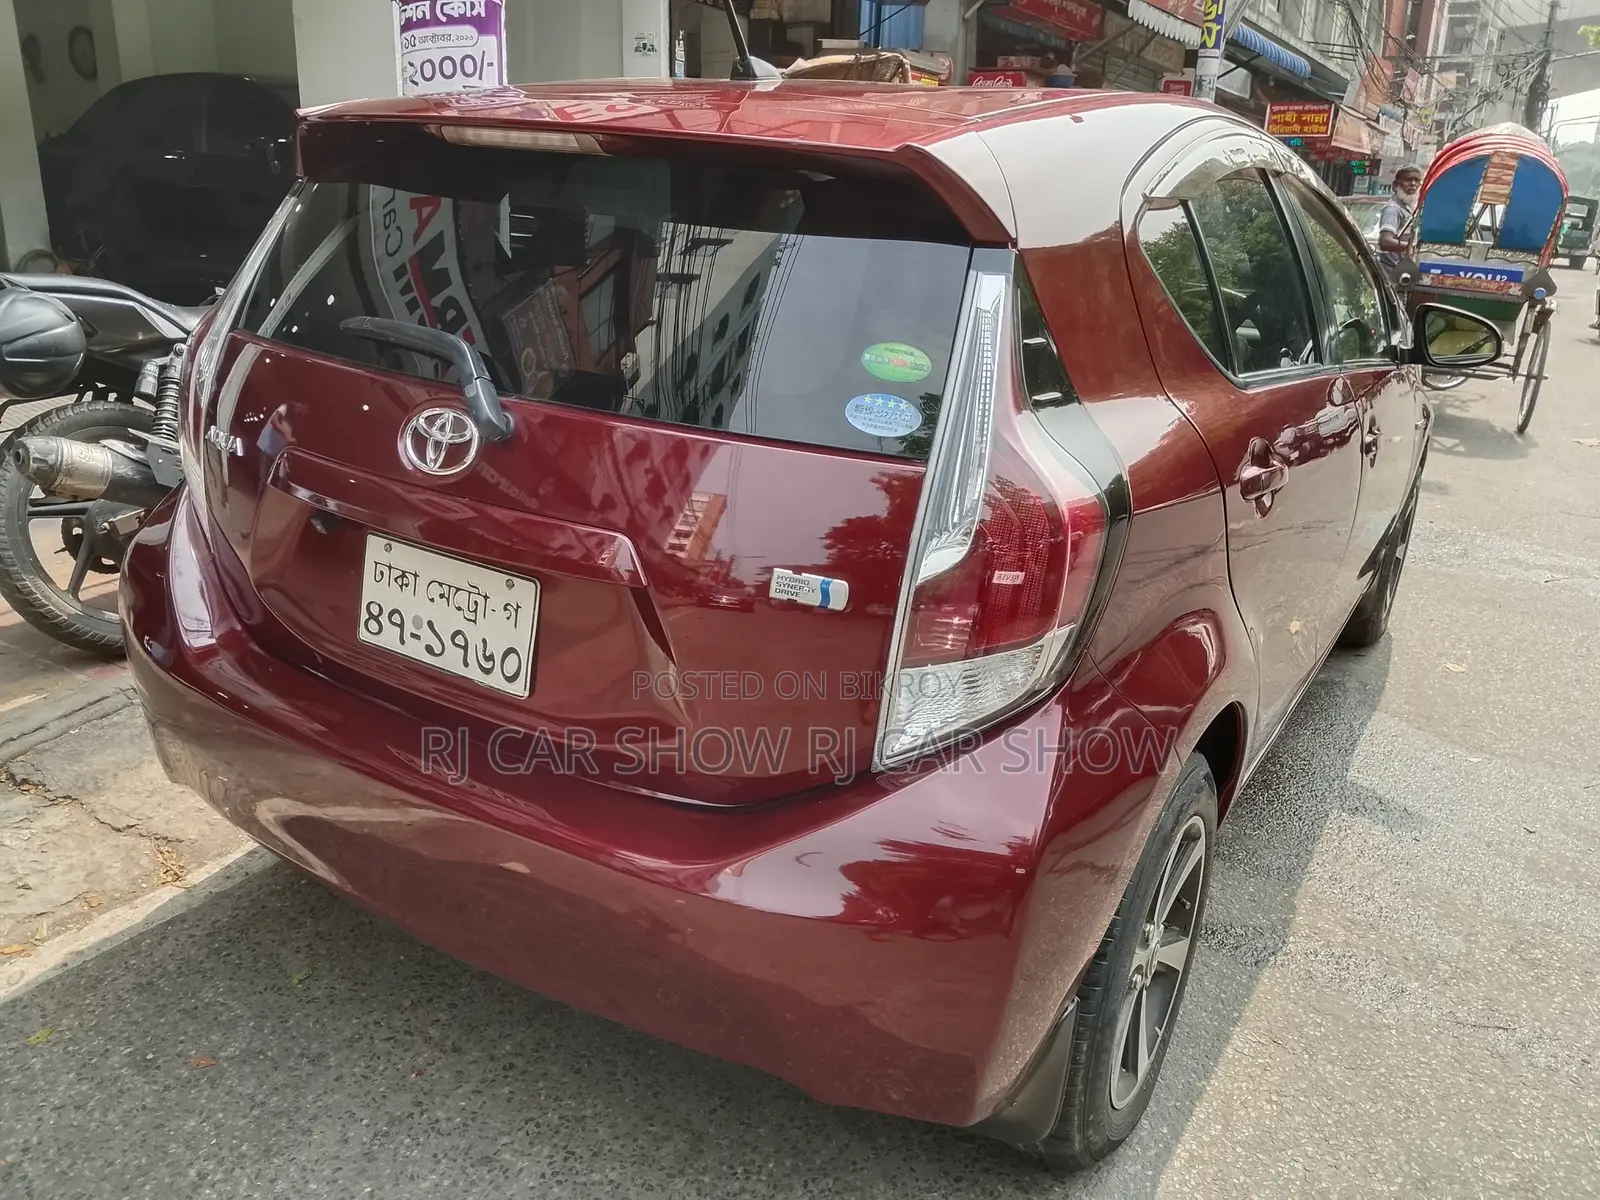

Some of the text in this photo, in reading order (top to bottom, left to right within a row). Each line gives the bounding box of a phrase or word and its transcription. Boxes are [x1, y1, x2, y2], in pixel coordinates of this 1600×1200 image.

[1271, 111, 1299, 123] শাহী
[373, 560, 420, 597] ঢাকা
[776, 574, 810, 586] HYBRID
[774, 587, 801, 598] DRIVE
[363, 600, 522, 684] ৪৭-১৭৬০
